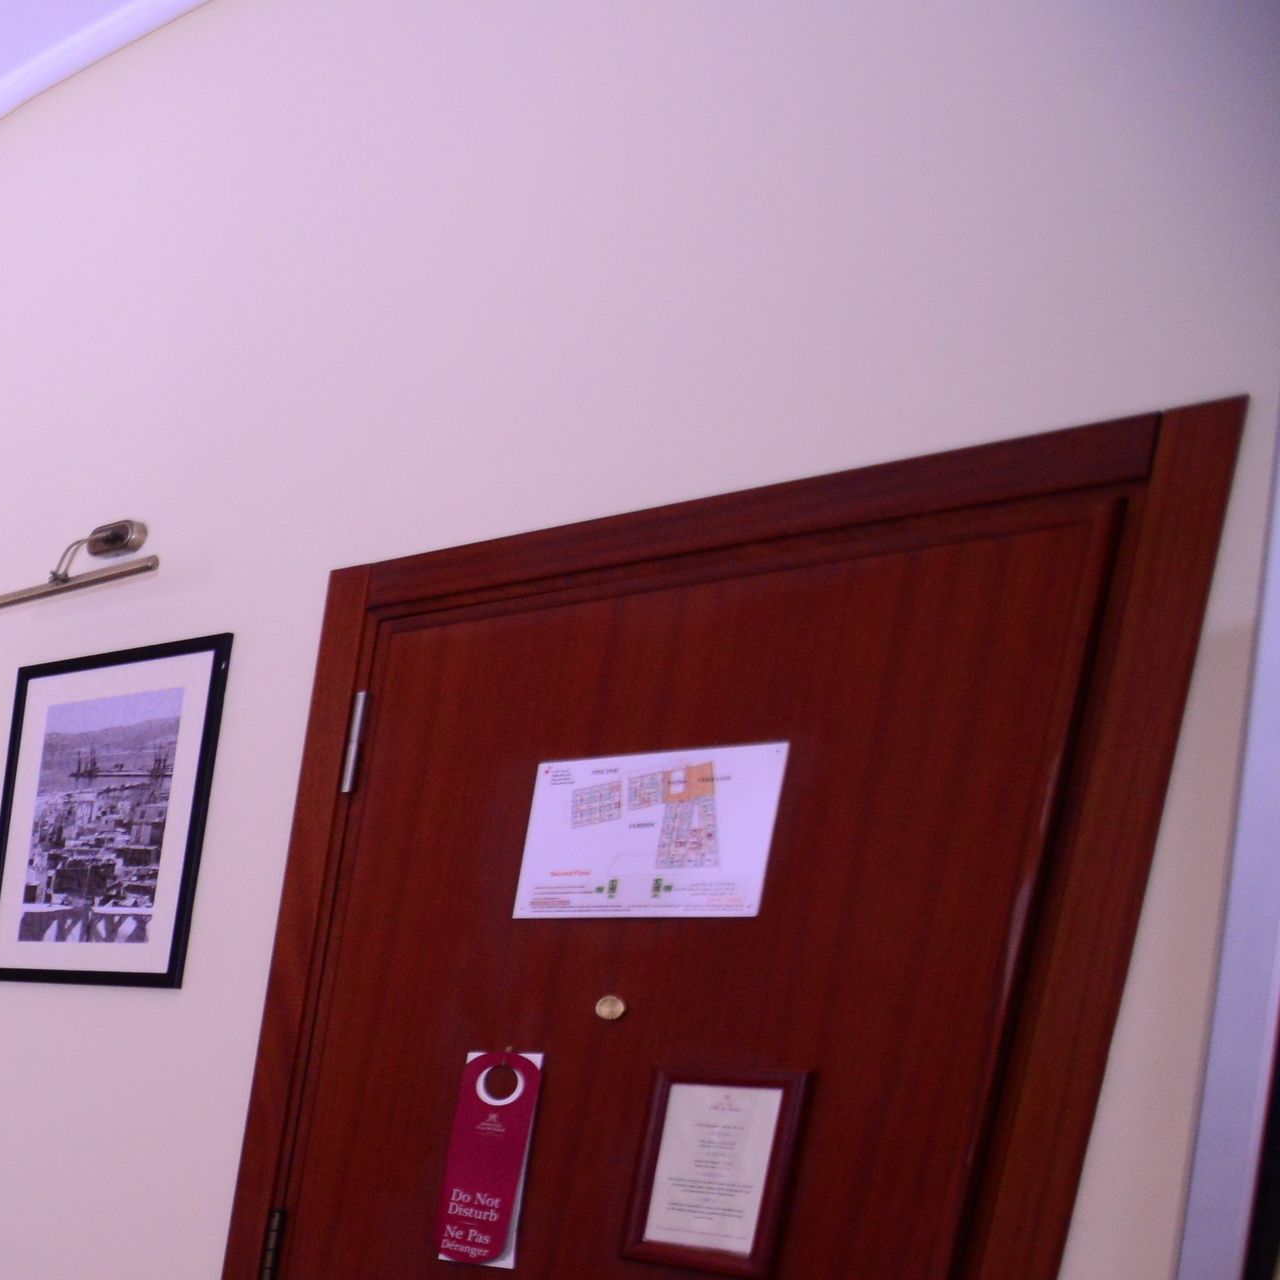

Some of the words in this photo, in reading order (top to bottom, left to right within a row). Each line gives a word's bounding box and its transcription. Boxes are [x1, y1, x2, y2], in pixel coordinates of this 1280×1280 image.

[451, 1188, 471, 1203] Do
[473, 1192, 501, 1208] Not
[448, 1202, 498, 1221] Disturb
[444, 1224, 464, 1239] Ne
[467, 1229, 490, 1244] Pas
[441, 1239, 489, 1257] Déranger
